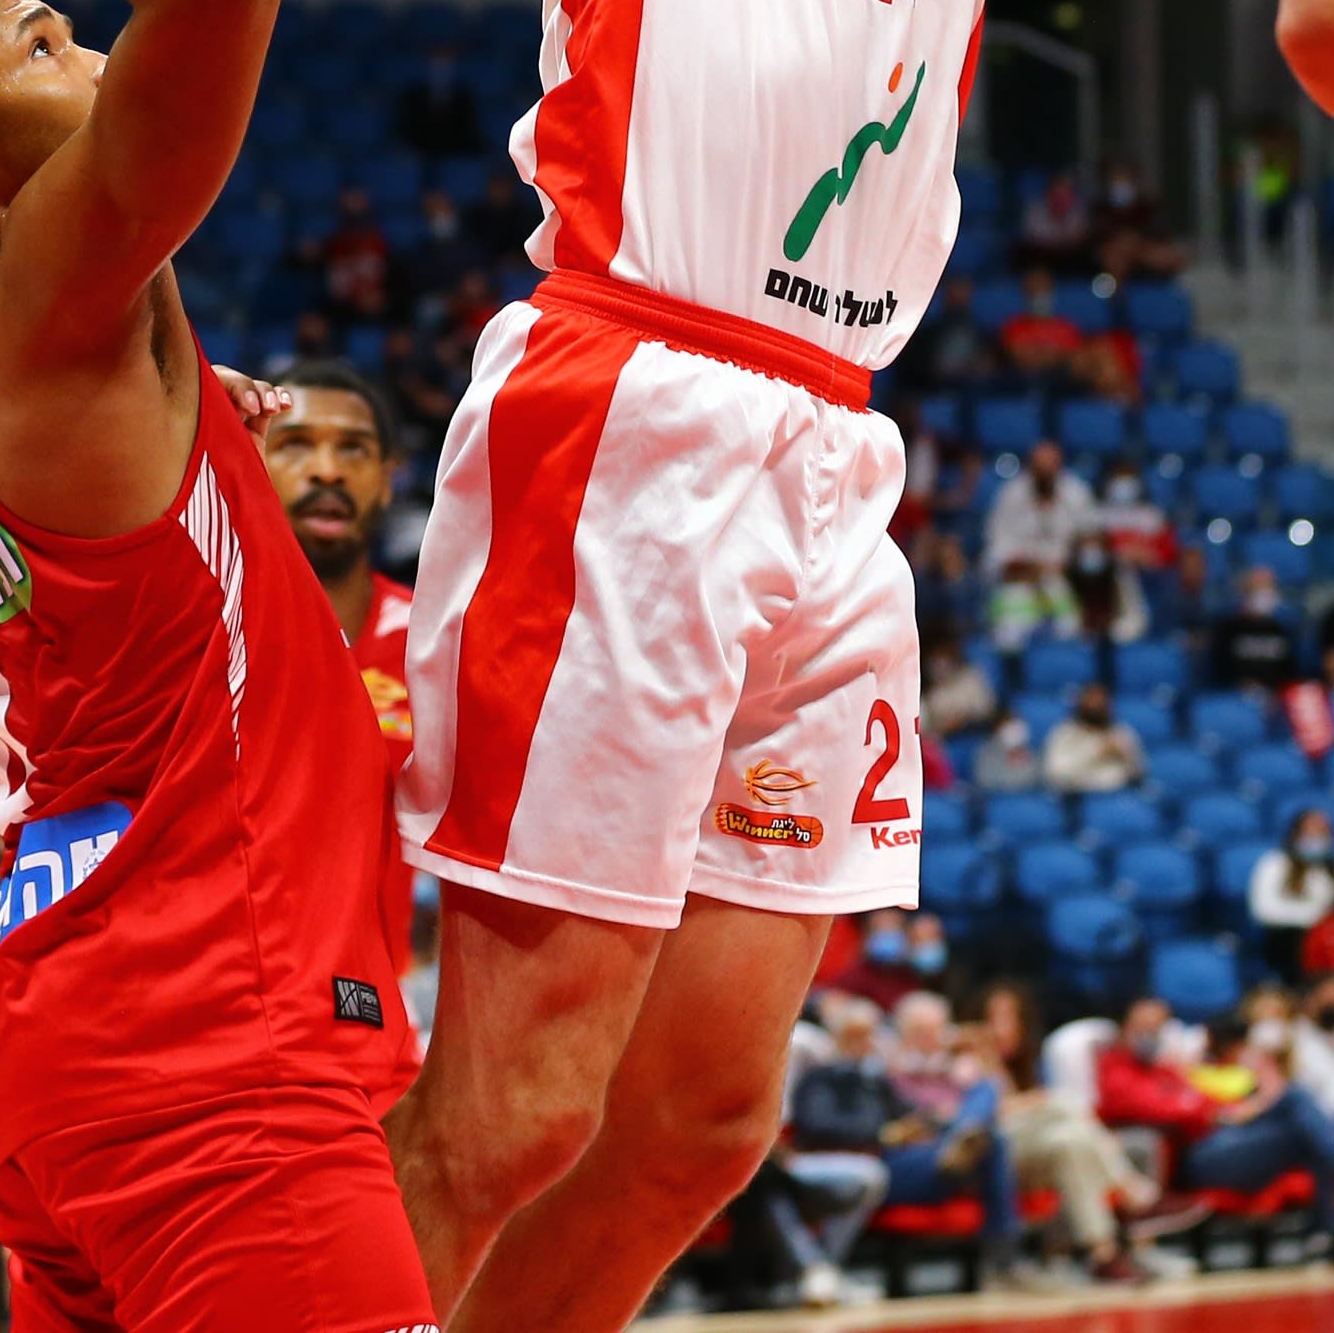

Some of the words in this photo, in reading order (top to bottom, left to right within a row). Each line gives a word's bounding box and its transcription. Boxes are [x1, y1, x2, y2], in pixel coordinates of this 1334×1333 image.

[764, 268, 828, 318] שחם
[728, 812, 794, 839] Winner
[771, 817, 795, 830] ליגת
[796, 827, 811, 842] סל
